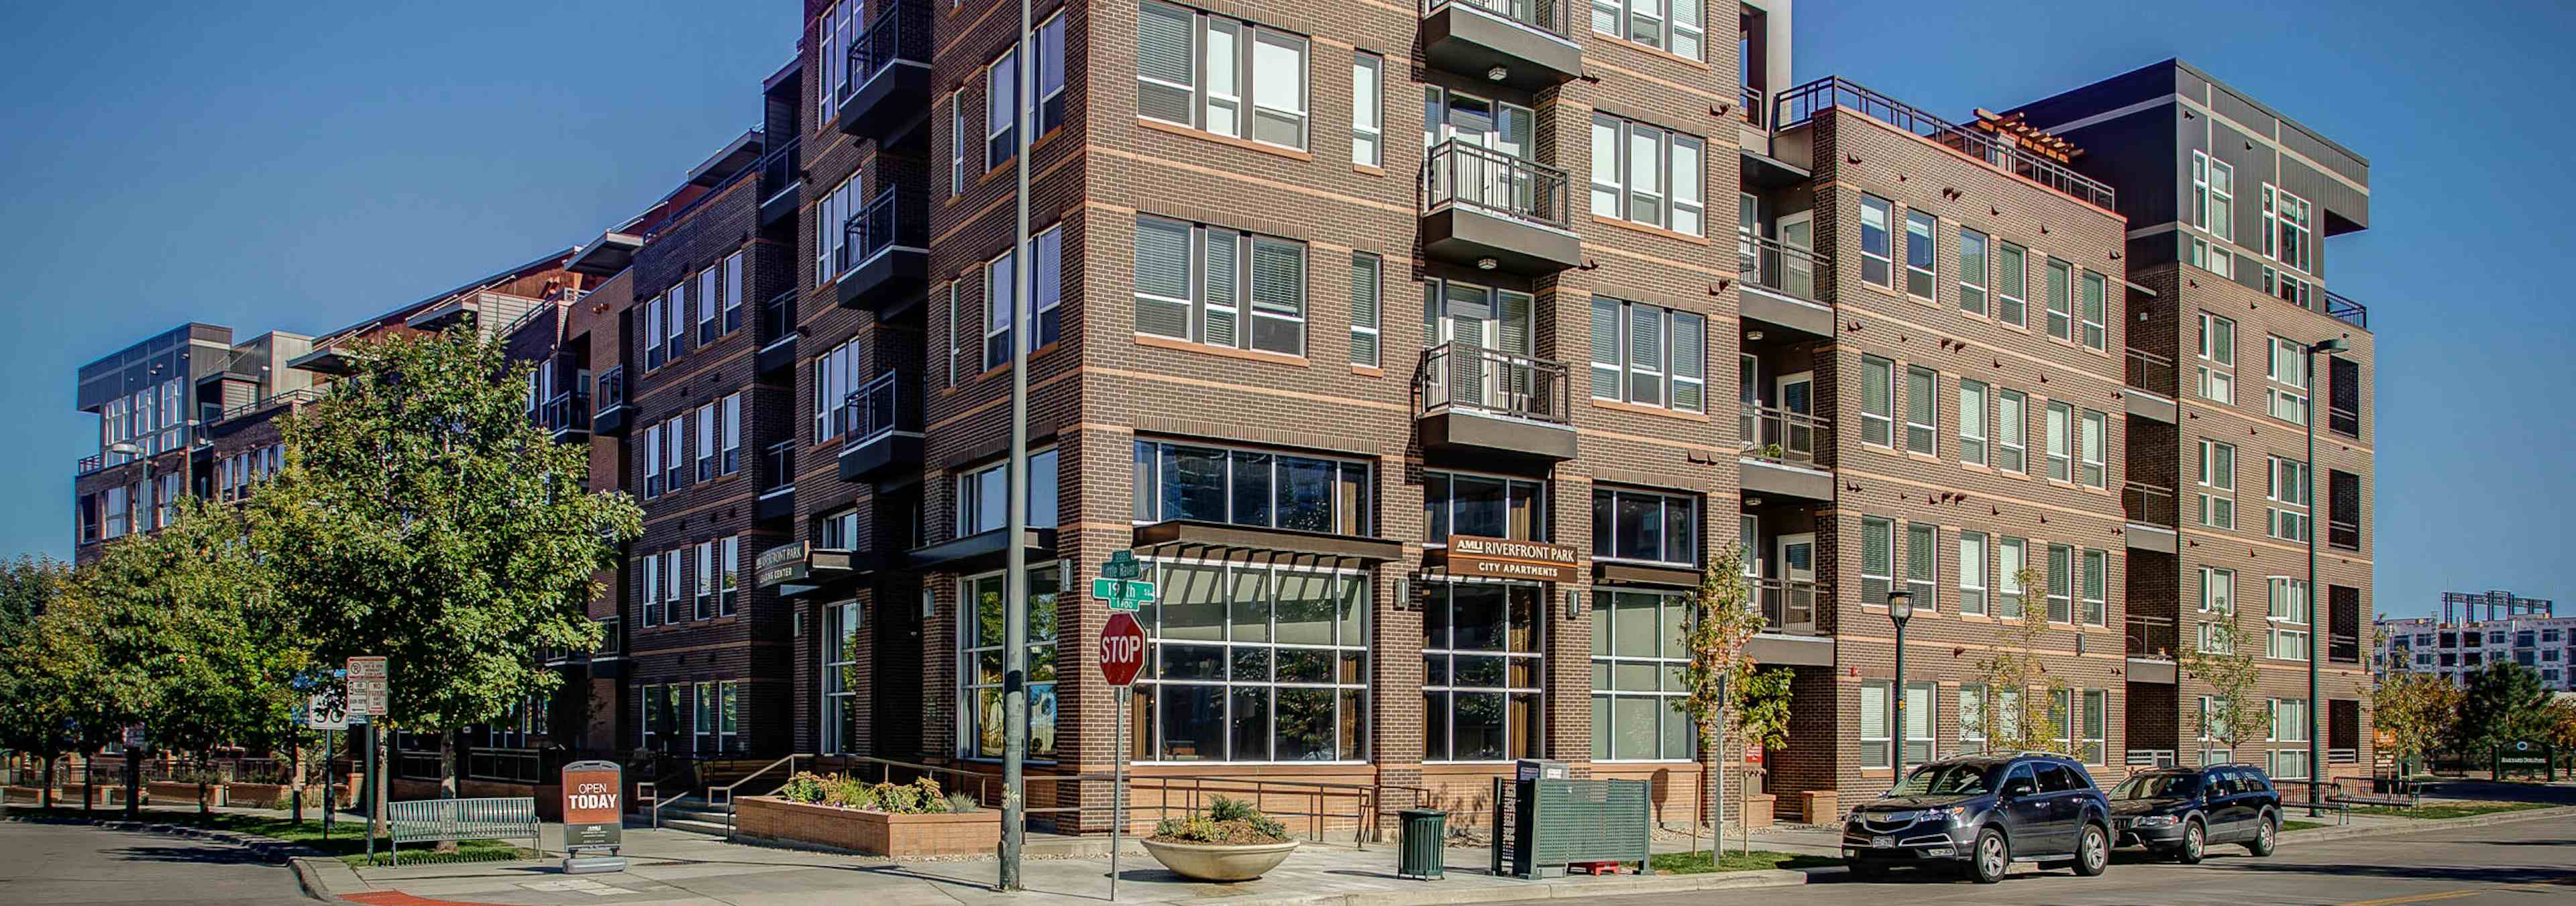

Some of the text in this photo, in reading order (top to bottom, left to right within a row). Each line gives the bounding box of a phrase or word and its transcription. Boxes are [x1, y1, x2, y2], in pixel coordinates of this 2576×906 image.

[1457, 540, 1574, 562] AMLI RIVERFRONT PARK
[1479, 562, 1558, 577] CITY APARTMENTS
[1108, 582, 1136, 598] 19th
[1101, 635, 1141, 664] STOP
[579, 783, 606, 794] OPEN
[568, 794, 617, 809] TODAY
